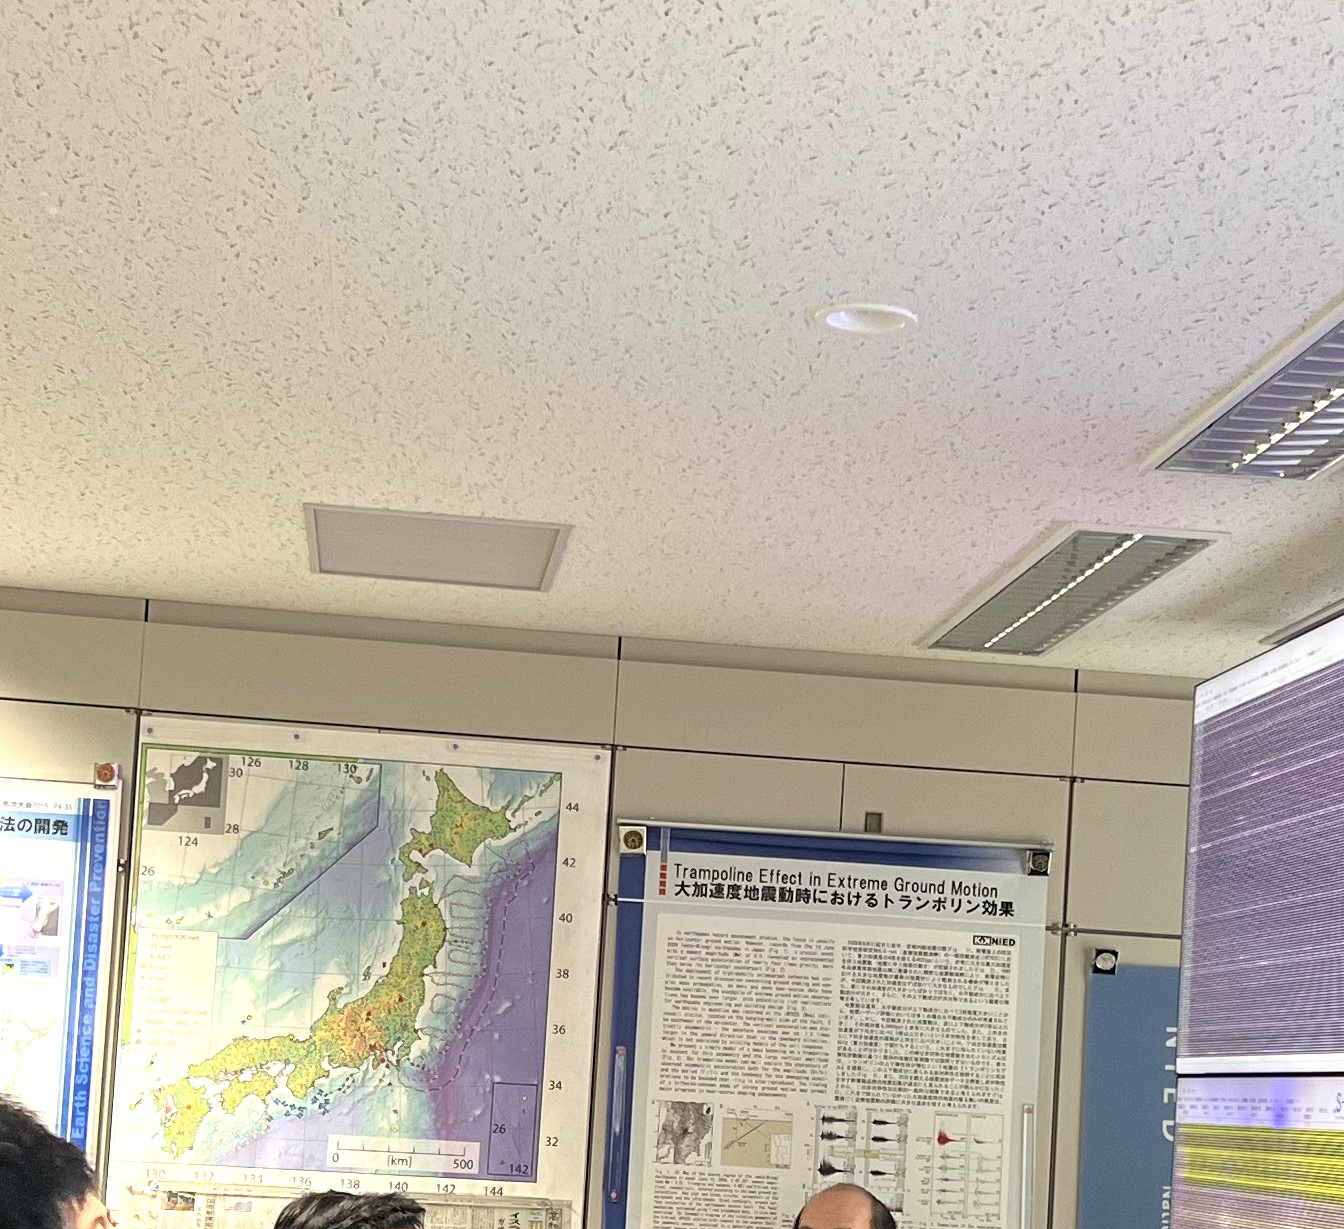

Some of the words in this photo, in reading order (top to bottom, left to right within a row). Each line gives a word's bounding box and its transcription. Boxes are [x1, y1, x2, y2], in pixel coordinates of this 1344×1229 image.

[241, 756, 262, 769] 126
[289, 759, 309, 771] 128
[229, 768, 244, 778] 30
[337, 763, 357, 775] 130
[566, 802, 580, 812] 44
[225, 824, 241, 834] 28
[90, 800, 108, 892] Prevention
[178, 835, 199, 847] 124
[562, 857, 576, 868] 42
[141, 866, 155, 876] 26
[674, 864, 753, 883] Trampoline
[759, 869, 803, 887] Effect
[809, 872, 822, 887] in
[827, 873, 889, 892] Extreme
[894, 877, 946, 896] Ground
[951, 881, 999, 899] Motion
[674, 882, 1016, 918] 大加速度地震動時におけるトランポリン効果
[558, 912, 573, 923] 40
[83, 897, 103, 971] Disaster
[555, 968, 570, 979] 38
[81, 977, 98, 1009] and
[552, 1023, 566, 1034] 36
[74, 1014, 94, 1085] Science
[548, 1079, 562, 1090] 34
[70, 1090, 89, 1139] Earth
[492, 1124, 506, 1135] 26
[545, 1136, 559, 1147] 32
[332, 1152, 340, 1163] 0
[387, 1154, 413, 1168] [km]
[452, 1158, 474, 1170] 500
[508, 1163, 529, 1174] 142
[290, 1176, 312, 1187] 136
[339, 1178, 361, 1190] 138
[388, 1181, 409, 1193] 140
[436, 1183, 457, 1195] 142
[483, 1185, 504, 1197] 144
